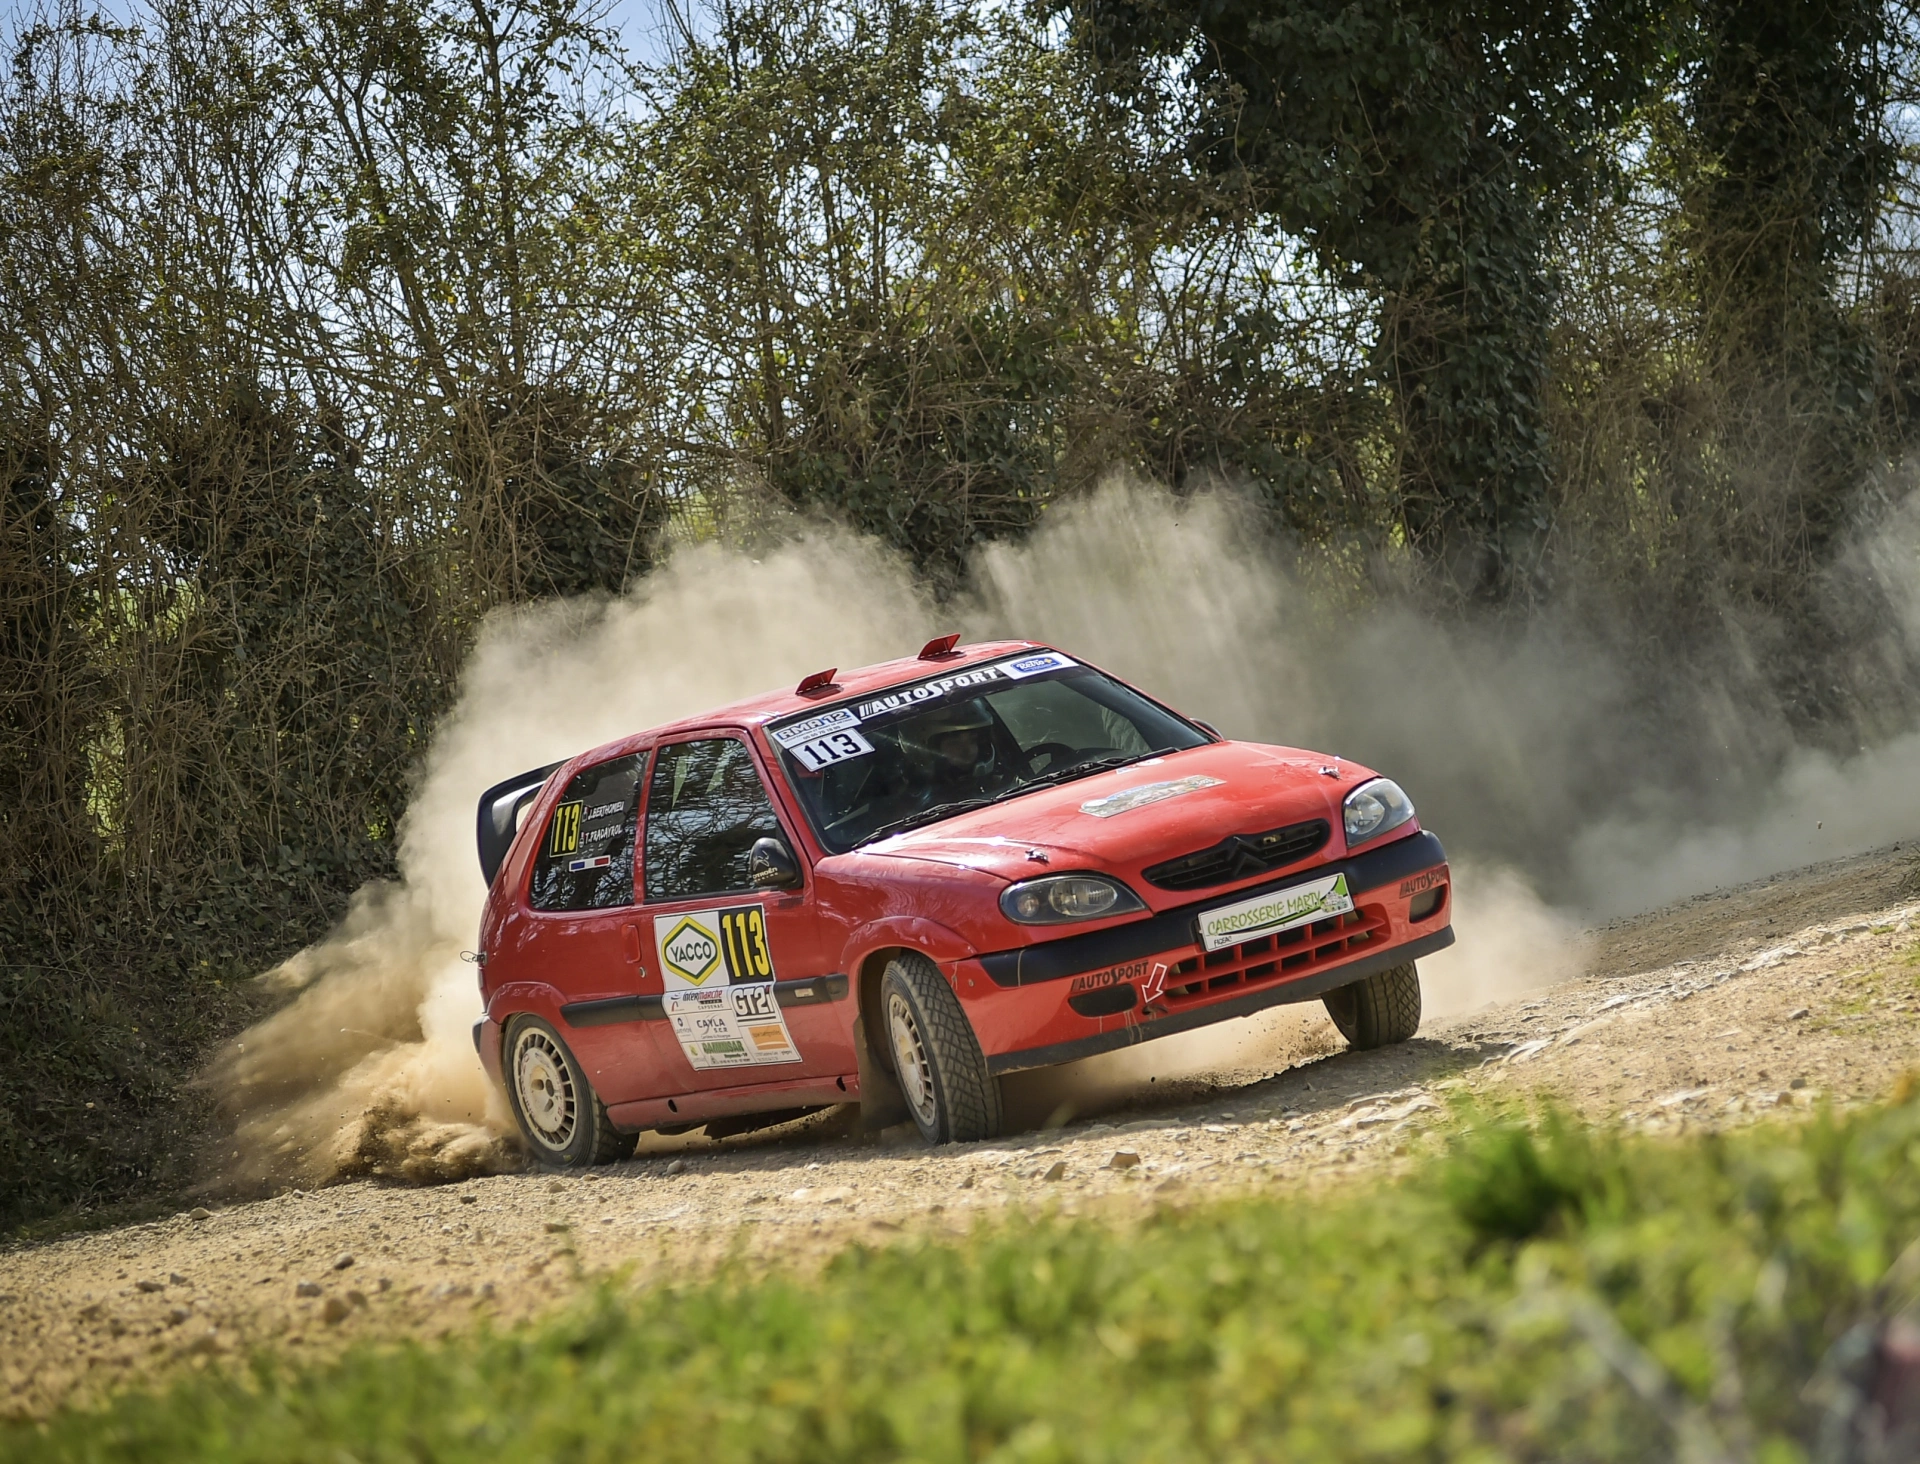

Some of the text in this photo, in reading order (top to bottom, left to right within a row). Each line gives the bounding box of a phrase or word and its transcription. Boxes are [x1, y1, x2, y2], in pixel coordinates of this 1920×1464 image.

[776, 717, 824, 740] RMA
[821, 710, 852, 725] 12
[803, 733, 862, 765] 113
[553, 803, 580, 853] 113
[1207, 891, 1322, 936] CARROSSERIE MARTY
[670, 941, 712, 963] YACCO
[722, 910, 770, 977] 113
[696, 1018, 726, 1028] CAYLA
